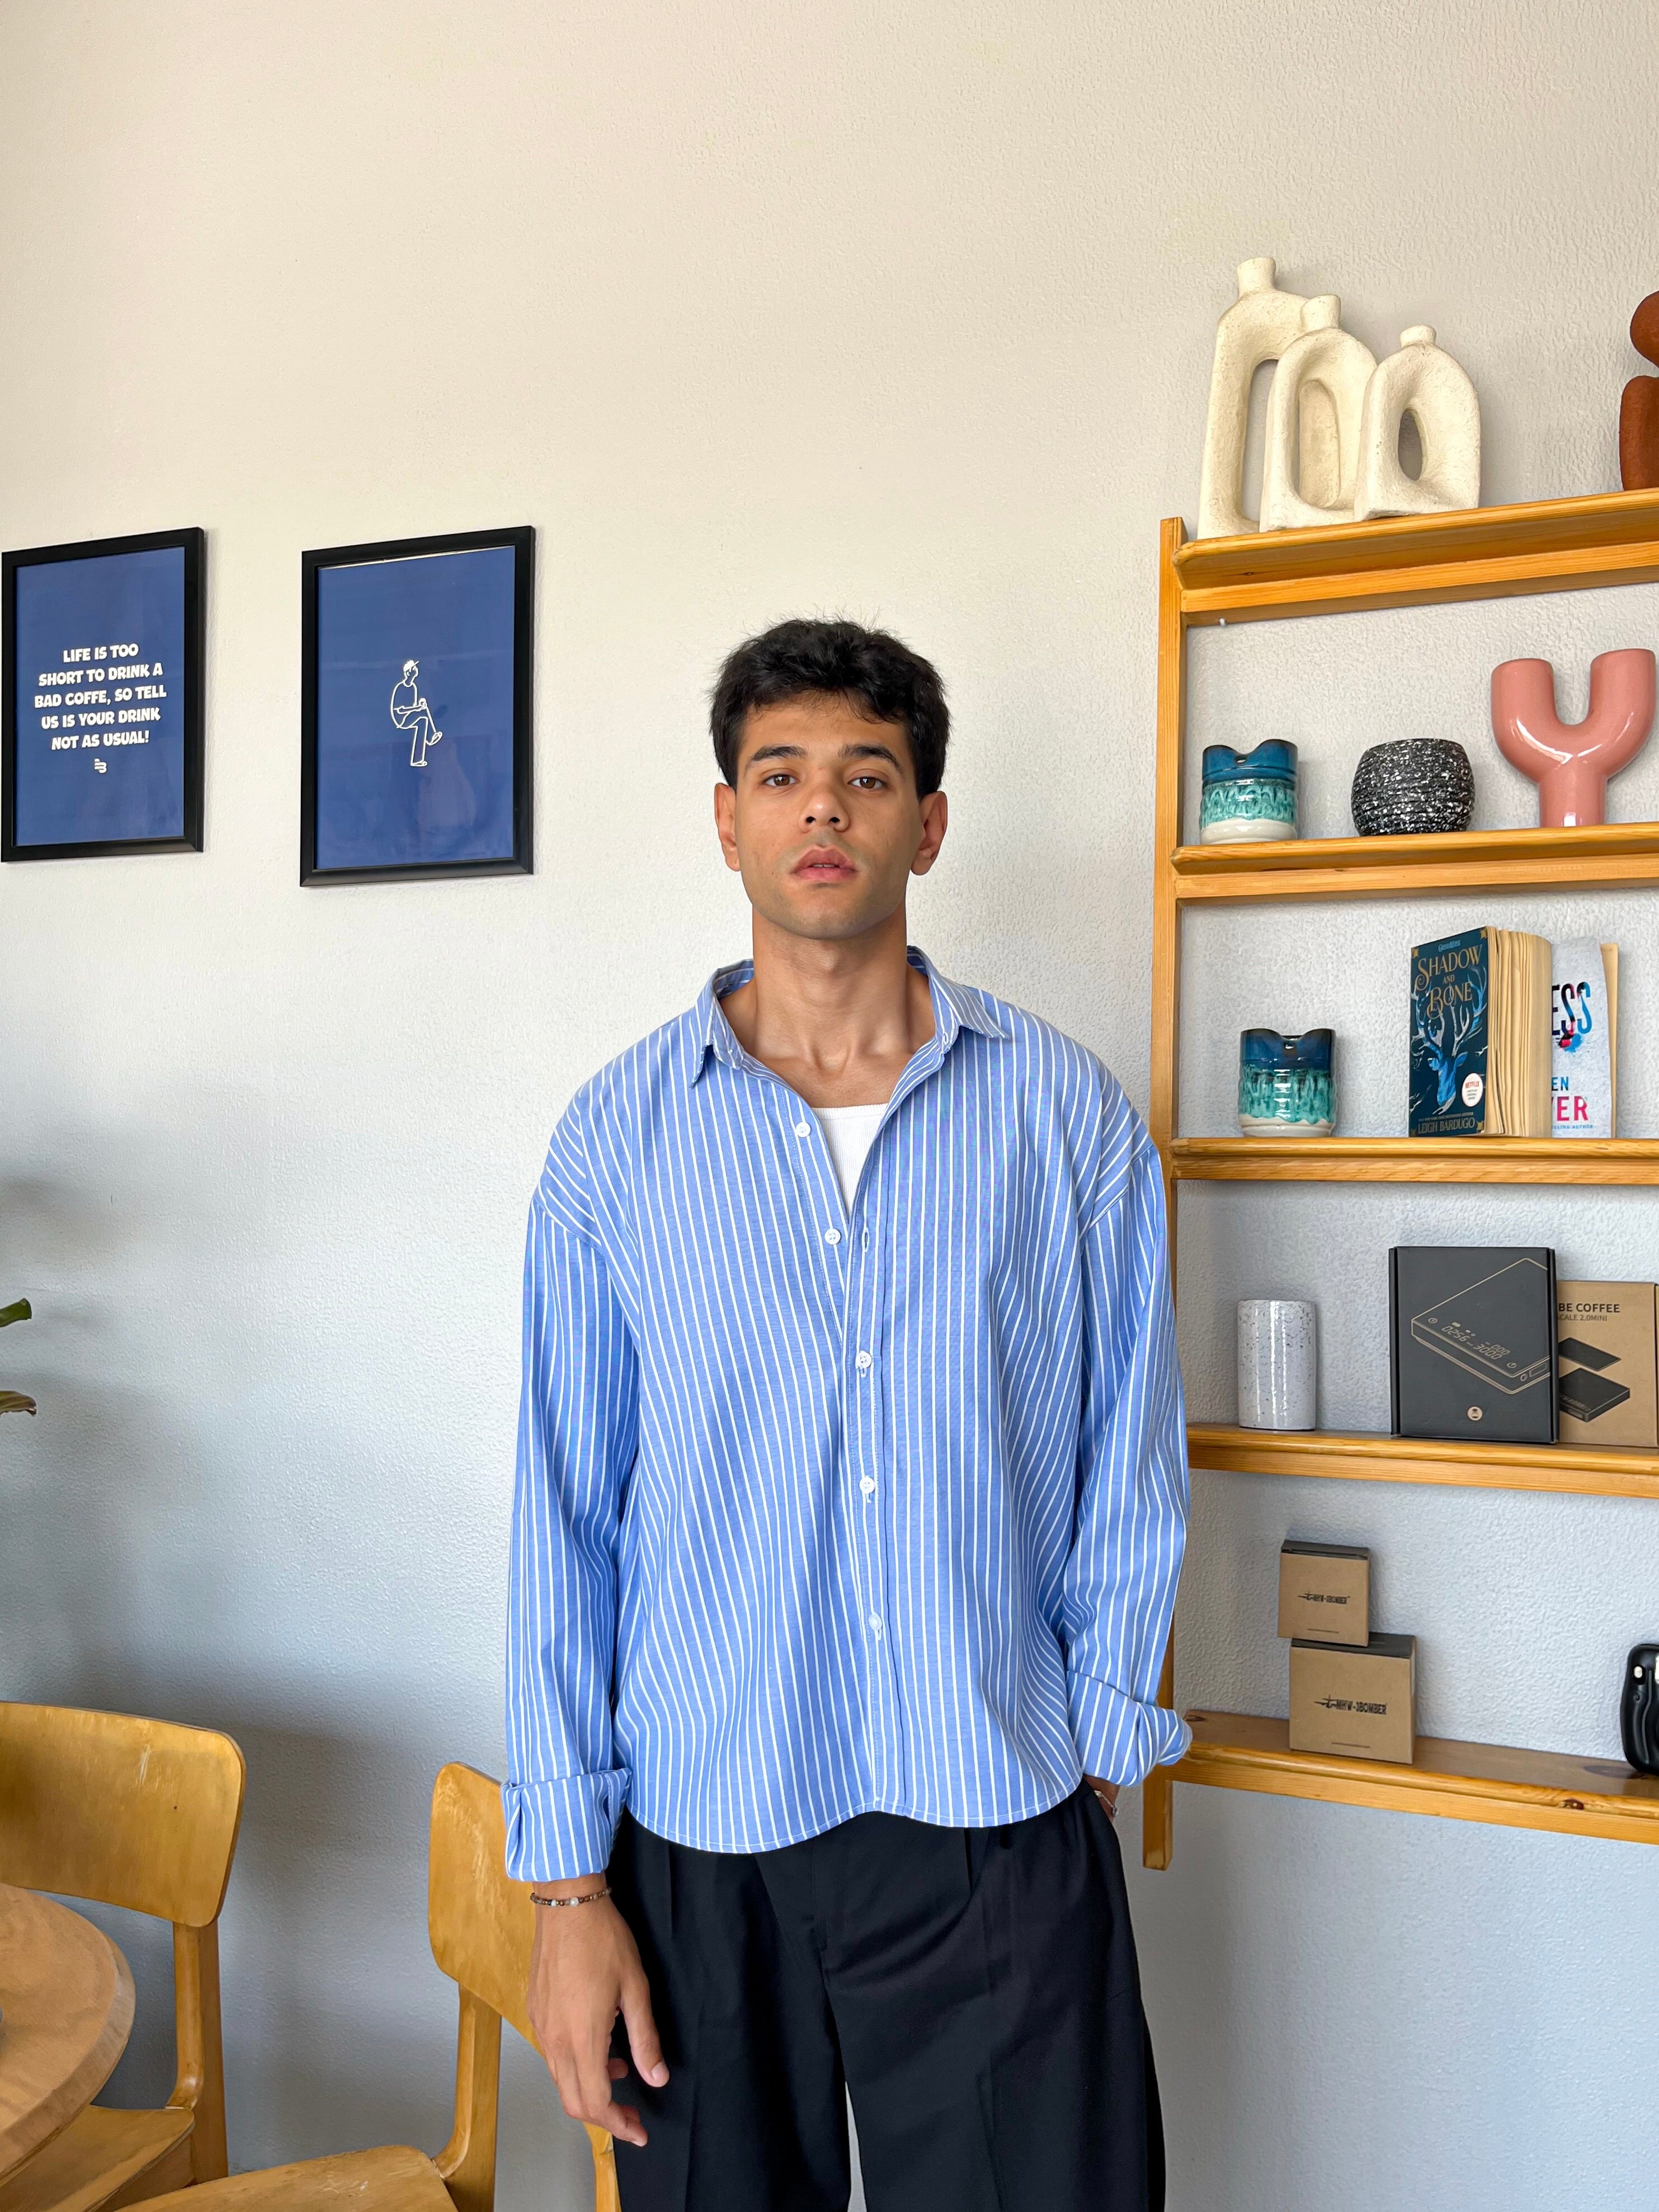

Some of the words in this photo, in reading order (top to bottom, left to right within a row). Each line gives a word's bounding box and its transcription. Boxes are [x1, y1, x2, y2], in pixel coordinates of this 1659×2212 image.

[63, 648, 91, 663] LIFE
[94, 646, 107, 660] IS
[110, 643, 139, 658] TOO
[38, 669, 83, 687] SHORT
[86, 668, 105, 682] TO
[108, 663, 150, 681] DRINK
[153, 662, 163, 676] A
[34, 694, 62, 709] BAD
[65, 690, 111, 705] COFFE,
[114, 687, 133, 702] SO
[135, 684, 167, 700] TELL
[41, 715, 59, 729] US
[62, 714, 76, 728] IS
[78, 711, 115, 727] YOUR
[118, 707, 161, 724] DRINK
[51, 735, 79, 751] NOT
[82, 734, 100, 748] AS
[103, 730, 149, 747] USUAL!
[1415, 944, 1482, 991] SHADOW
[1443, 974, 1455, 984] AND
[1427, 982, 1473, 1020] BONE
[1418, 1121, 1438, 1134] LEIGH
[1440, 1117, 1476, 1131] BARDUGO
[1576, 1303, 1620, 1313] COFFEE
